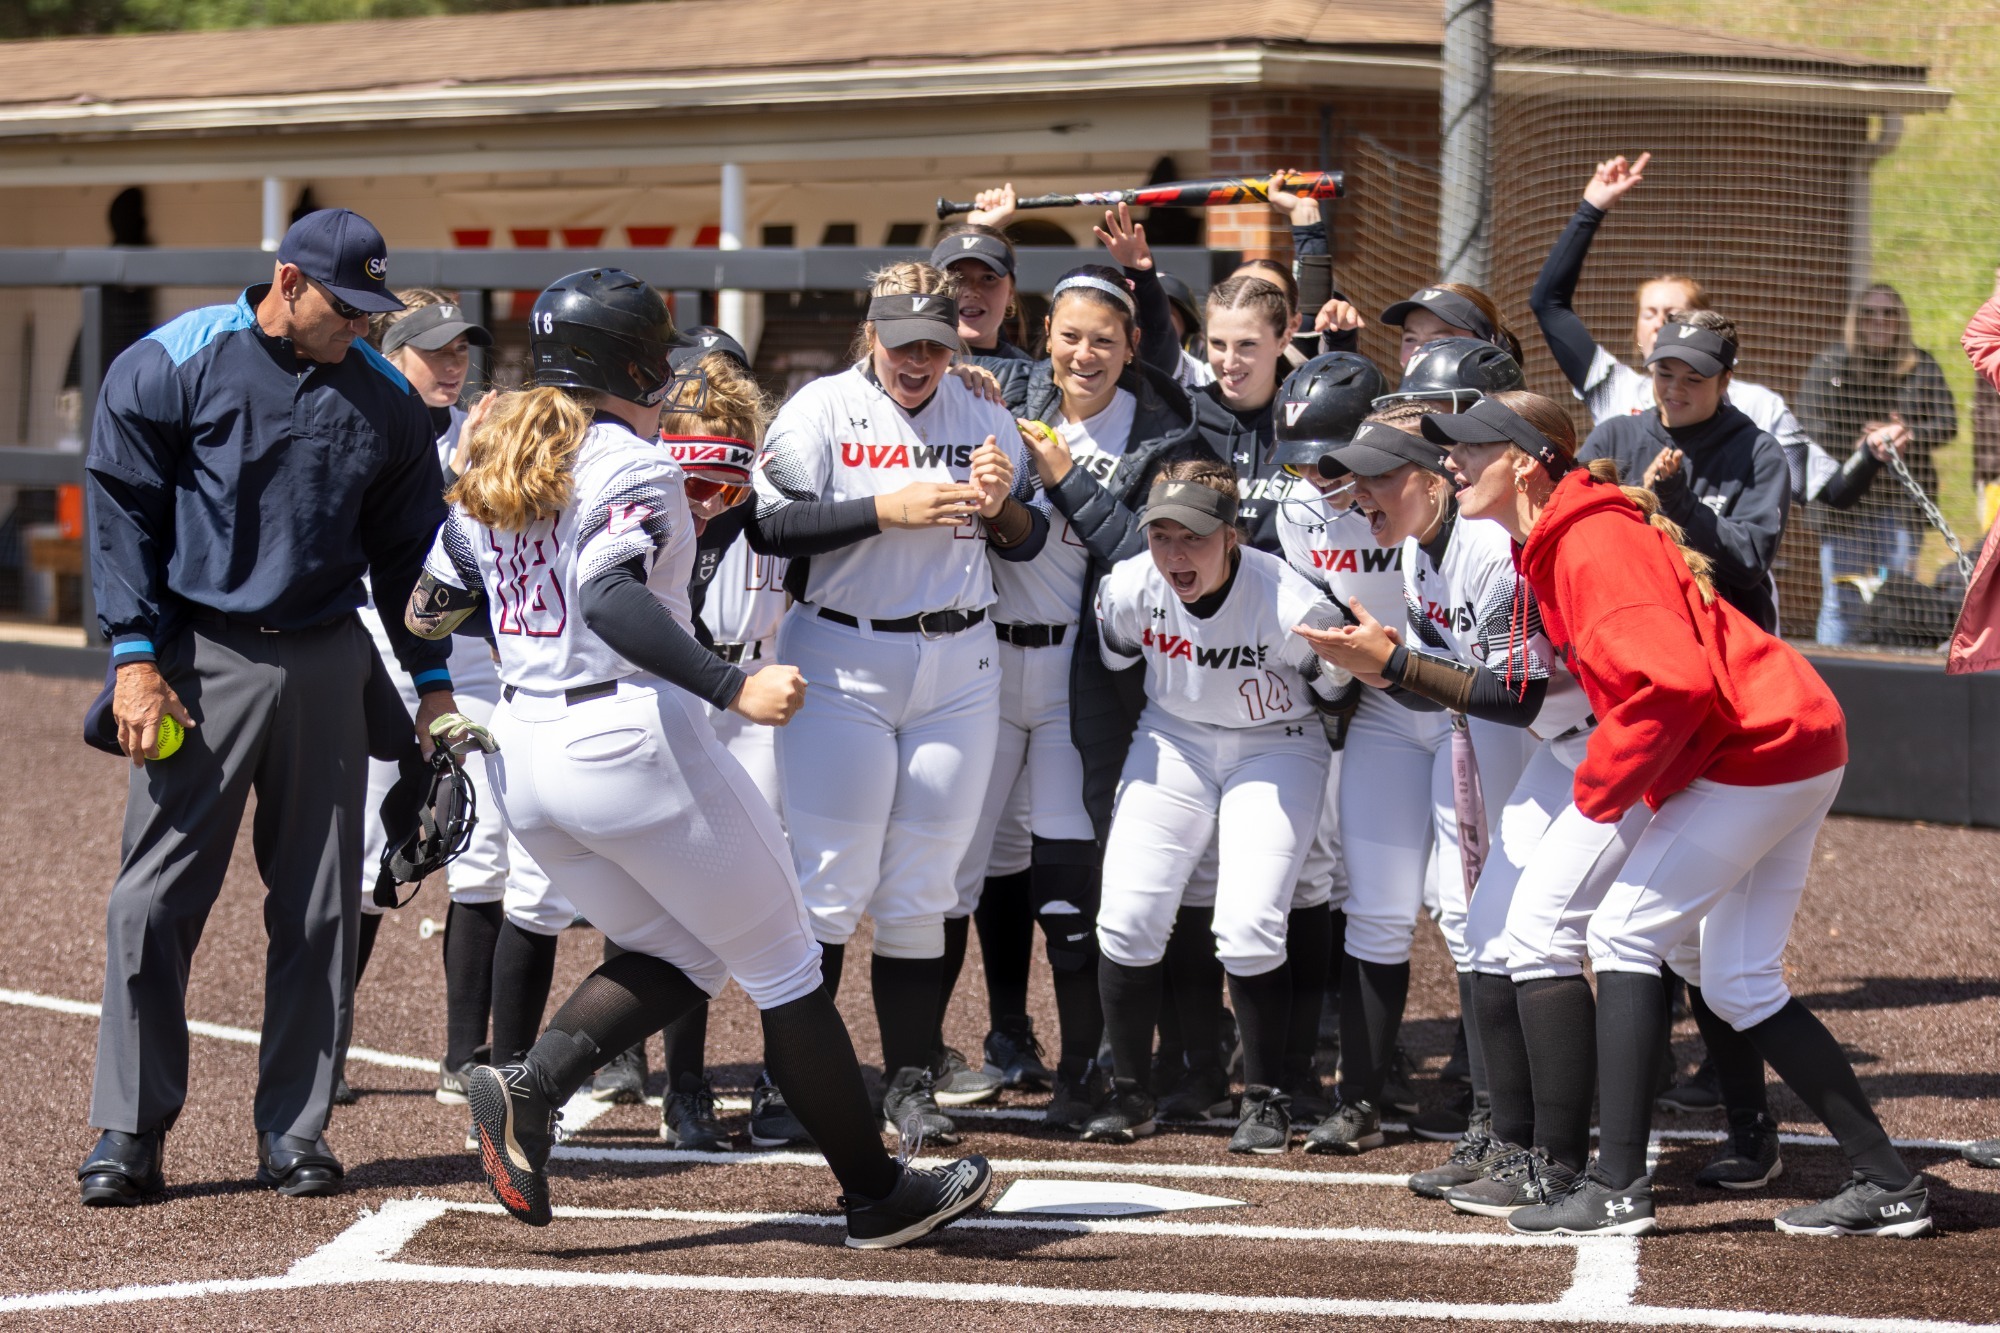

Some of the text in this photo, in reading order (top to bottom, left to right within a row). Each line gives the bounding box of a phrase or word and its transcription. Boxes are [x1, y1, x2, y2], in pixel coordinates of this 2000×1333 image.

[961, 237, 980, 249] V
[1422, 290, 1442, 301] V
[911, 297, 930, 312] V
[439, 306, 453, 319] V
[534, 312, 553, 335] 18
[1678, 325, 1698, 339] V
[701, 336, 719, 348] V
[1285, 402, 1311, 427] V
[1356, 425, 1374, 440] V
[841, 442, 983, 468] UVAWIS
[1166, 483, 1186, 497] V
[608, 502, 655, 535] V
[489, 510, 566, 638] 18
[1239, 670, 1293, 721] 14
[443, 1078, 464, 1093] UA
[1879, 1201, 1912, 1218] UA
